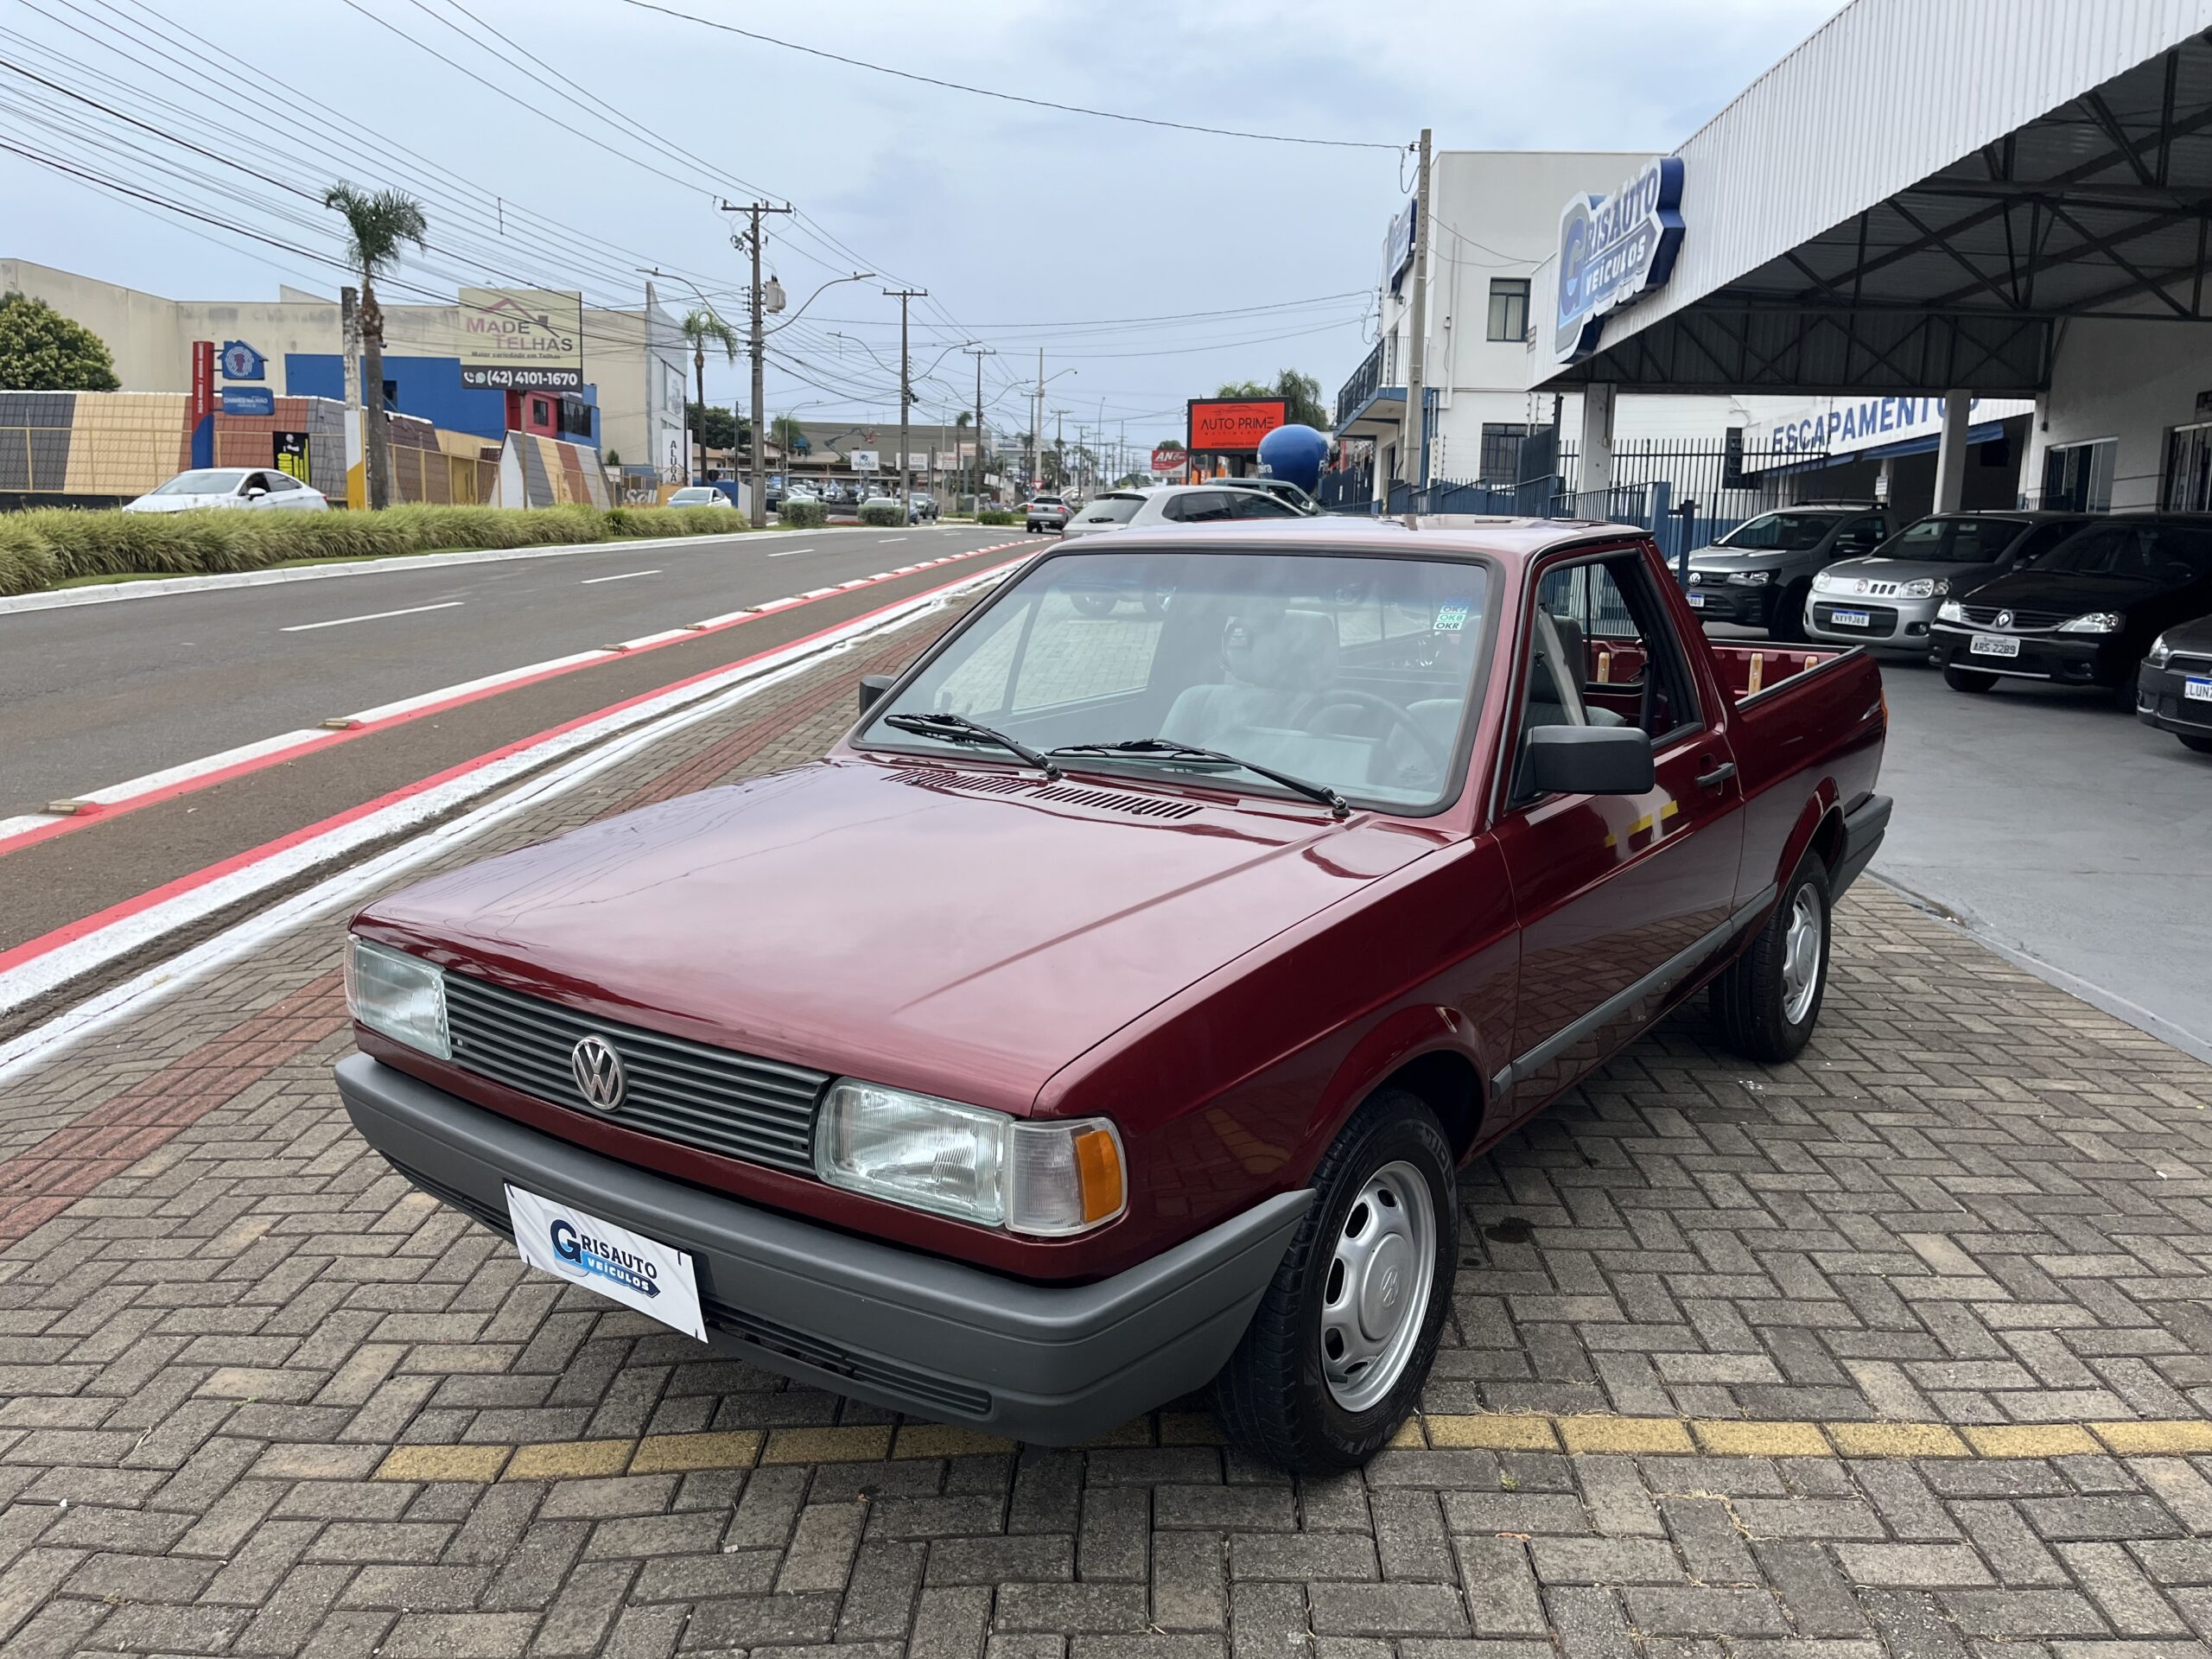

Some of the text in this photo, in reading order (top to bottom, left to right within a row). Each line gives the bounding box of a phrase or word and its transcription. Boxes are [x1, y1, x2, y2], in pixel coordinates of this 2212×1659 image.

[1560, 168, 1658, 317] GRISAUTO
[466, 317, 531, 334] MADE
[493, 334, 573, 352] TELHAS
[486, 370, 578, 386] (42) 4101-1670
[1200, 416, 1274, 430] AUTO PRIME
[1772, 397, 1979, 454] ESCAPAMENT
[1993, 644, 2016, 655] 2289
[550, 1219, 658, 1281] GRISAUTO
[588, 1256, 650, 1291] VEÍCULOS
